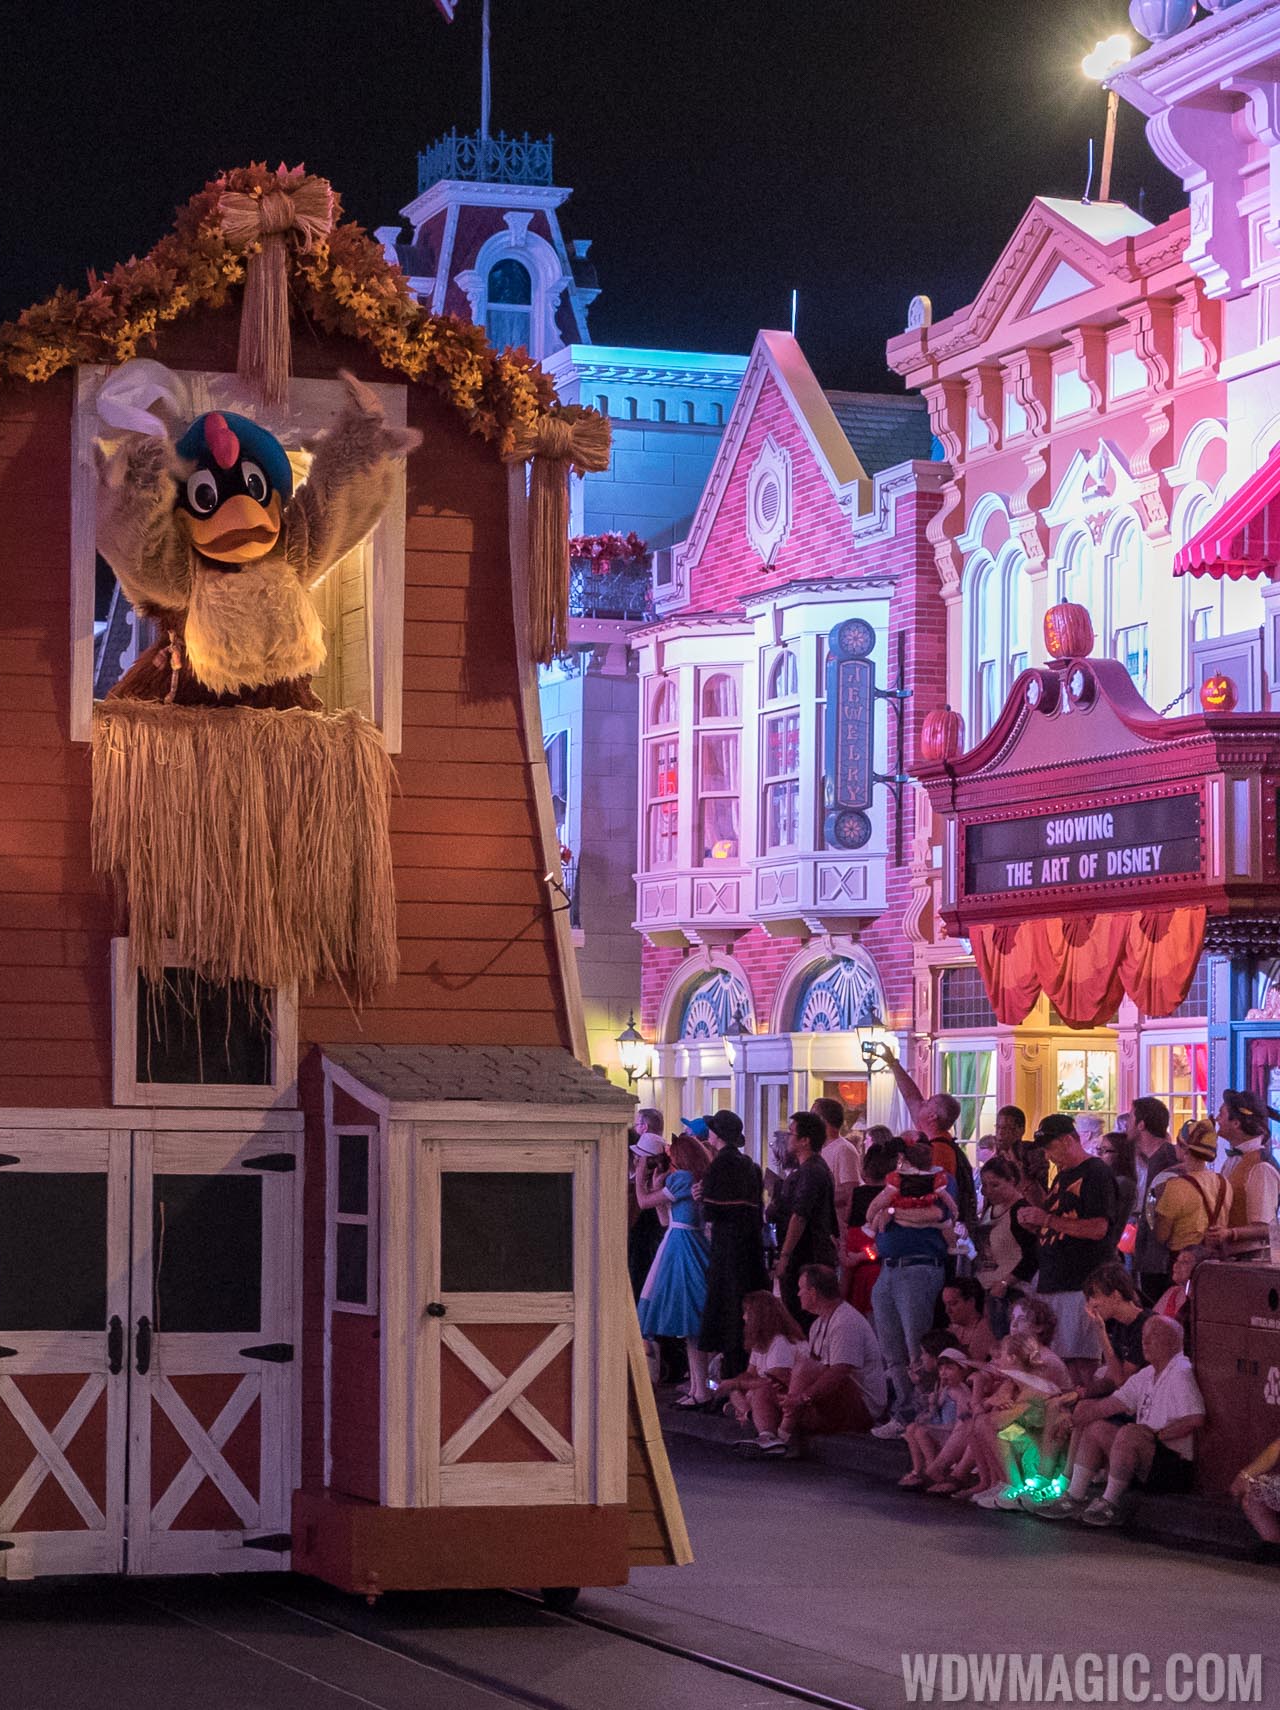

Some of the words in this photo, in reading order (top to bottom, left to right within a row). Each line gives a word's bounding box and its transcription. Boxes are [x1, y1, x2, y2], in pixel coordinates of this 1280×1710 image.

[844, 667, 864, 801] JEWELRY
[1046, 812, 1114, 846] SHOWING
[1006, 861, 1033, 887] THE
[1041, 857, 1070, 883] ART
[1079, 853, 1099, 879] OF
[1107, 845, 1163, 876] DISNEY
